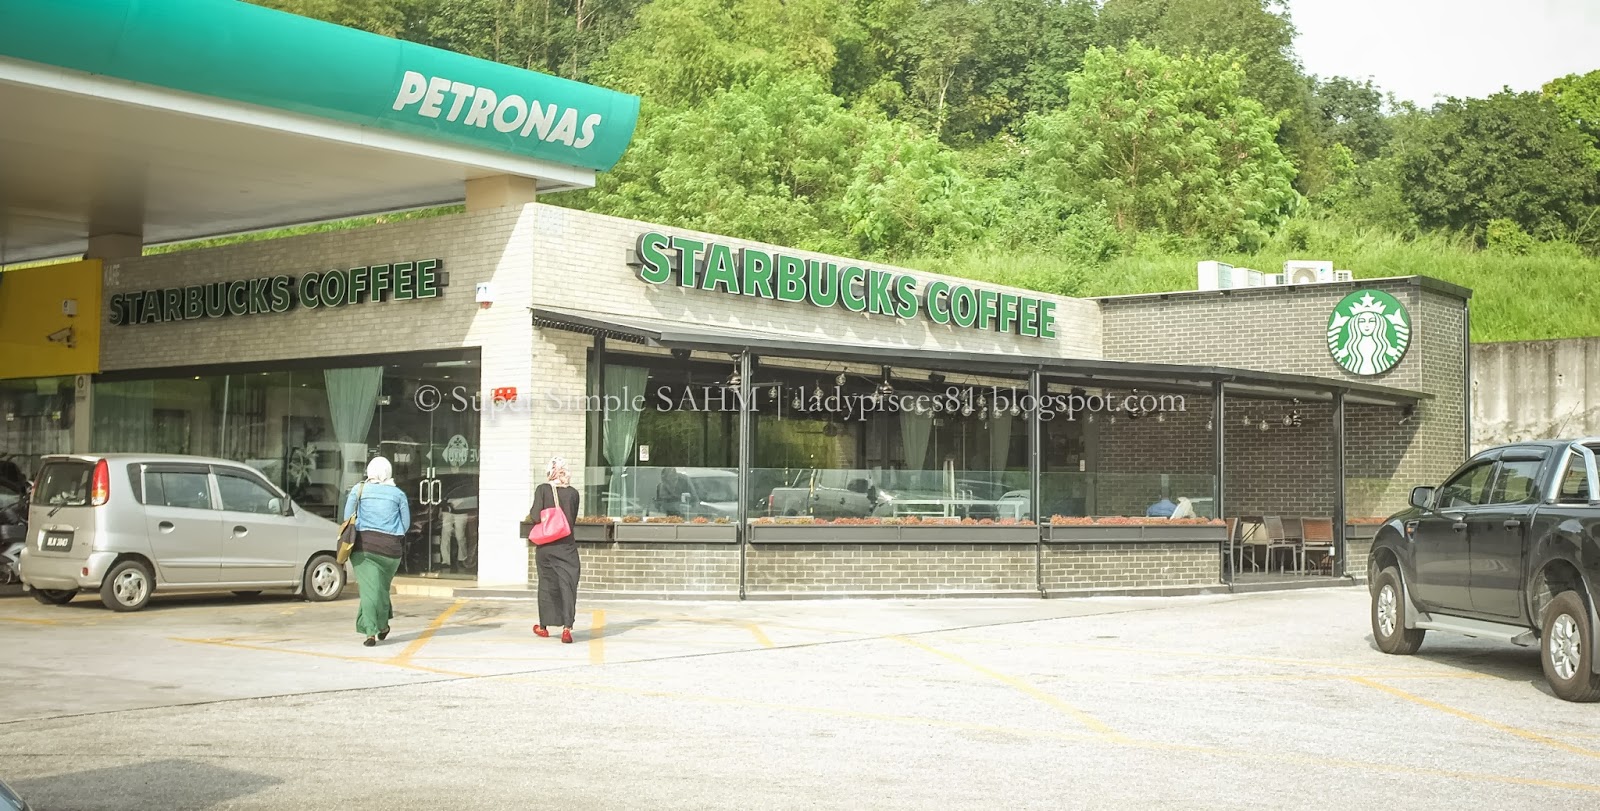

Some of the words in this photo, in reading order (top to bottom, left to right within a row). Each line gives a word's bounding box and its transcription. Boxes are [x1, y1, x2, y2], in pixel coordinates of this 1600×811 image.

[393, 71, 602, 149] PETRONAS
[109, 274, 294, 326] STARBUCKS
[298, 258, 442, 310] COFFEE
[637, 231, 918, 320] STARBUCKS
[922, 279, 1057, 339] COFFEE
